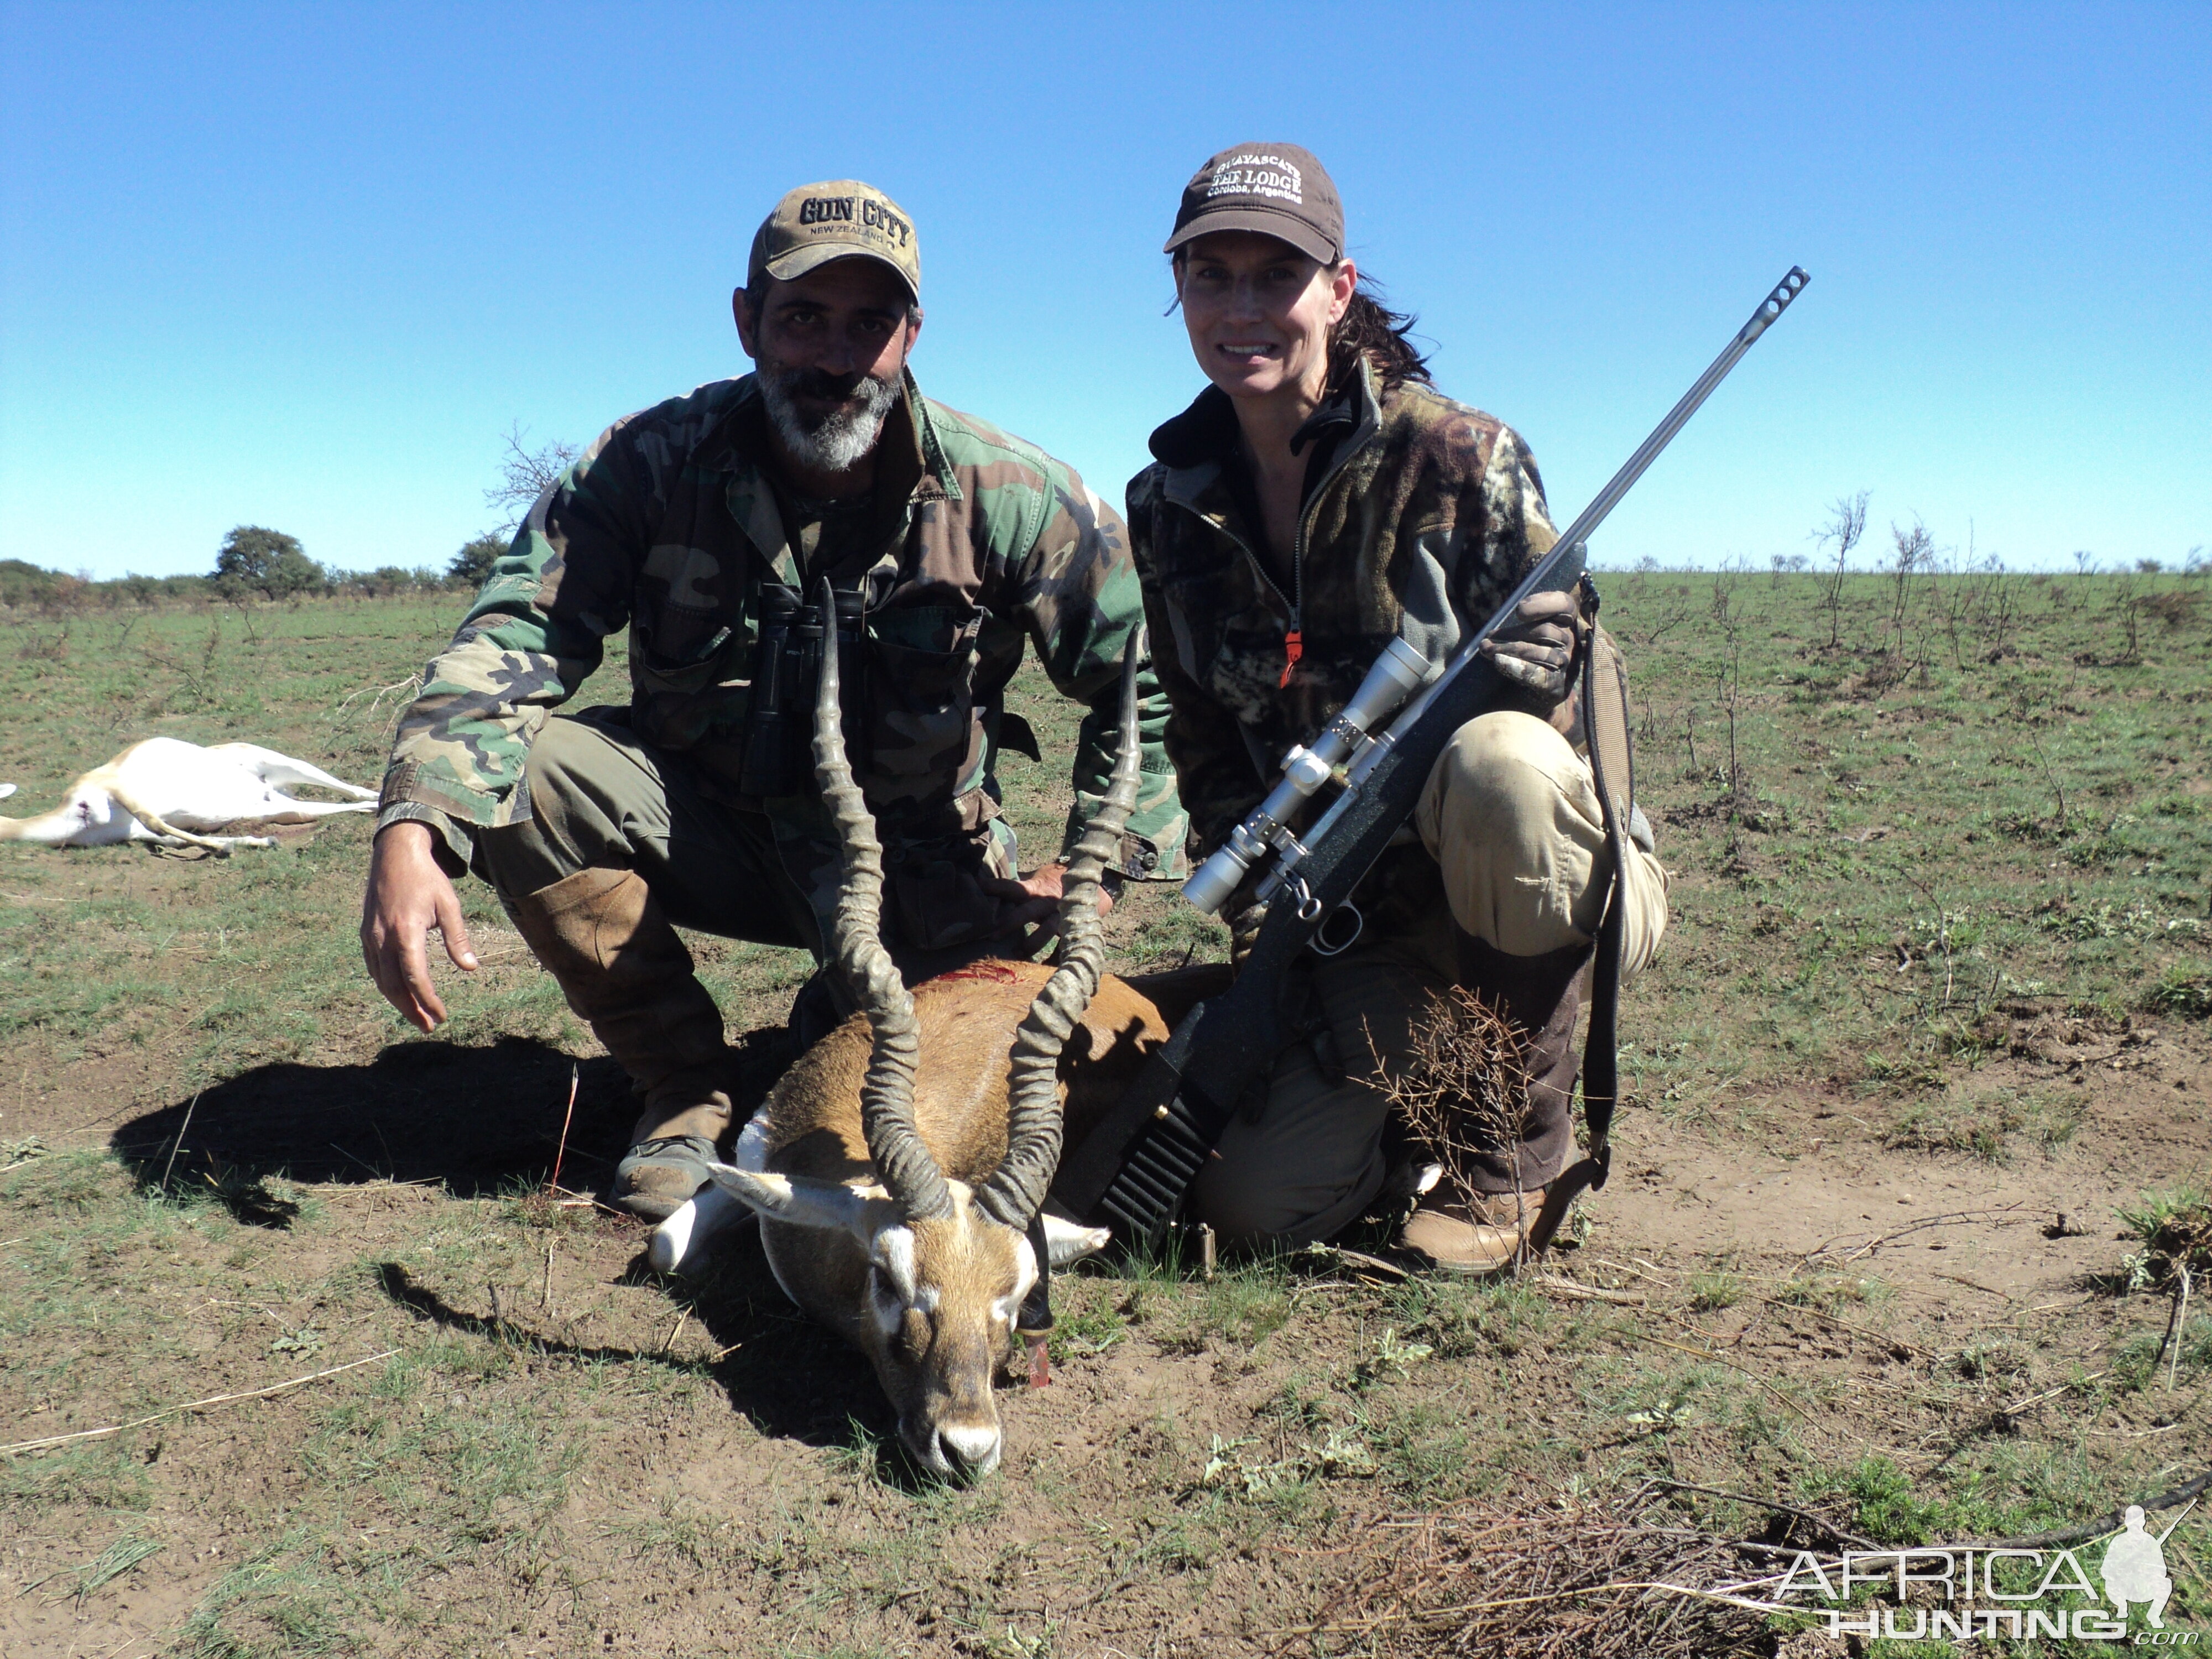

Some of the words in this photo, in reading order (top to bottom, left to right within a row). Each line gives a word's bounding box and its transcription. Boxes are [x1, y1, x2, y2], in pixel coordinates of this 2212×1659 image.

[1212, 170, 1242, 186] THE
[1244, 170, 1302, 194] LODGE
[1253, 184, 1302, 205] Argentina
[800, 197, 855, 225] GUN
[863, 199, 910, 248] CITY
[811, 226, 834, 235] NEW
[837, 226, 883, 243] ZEALAND
